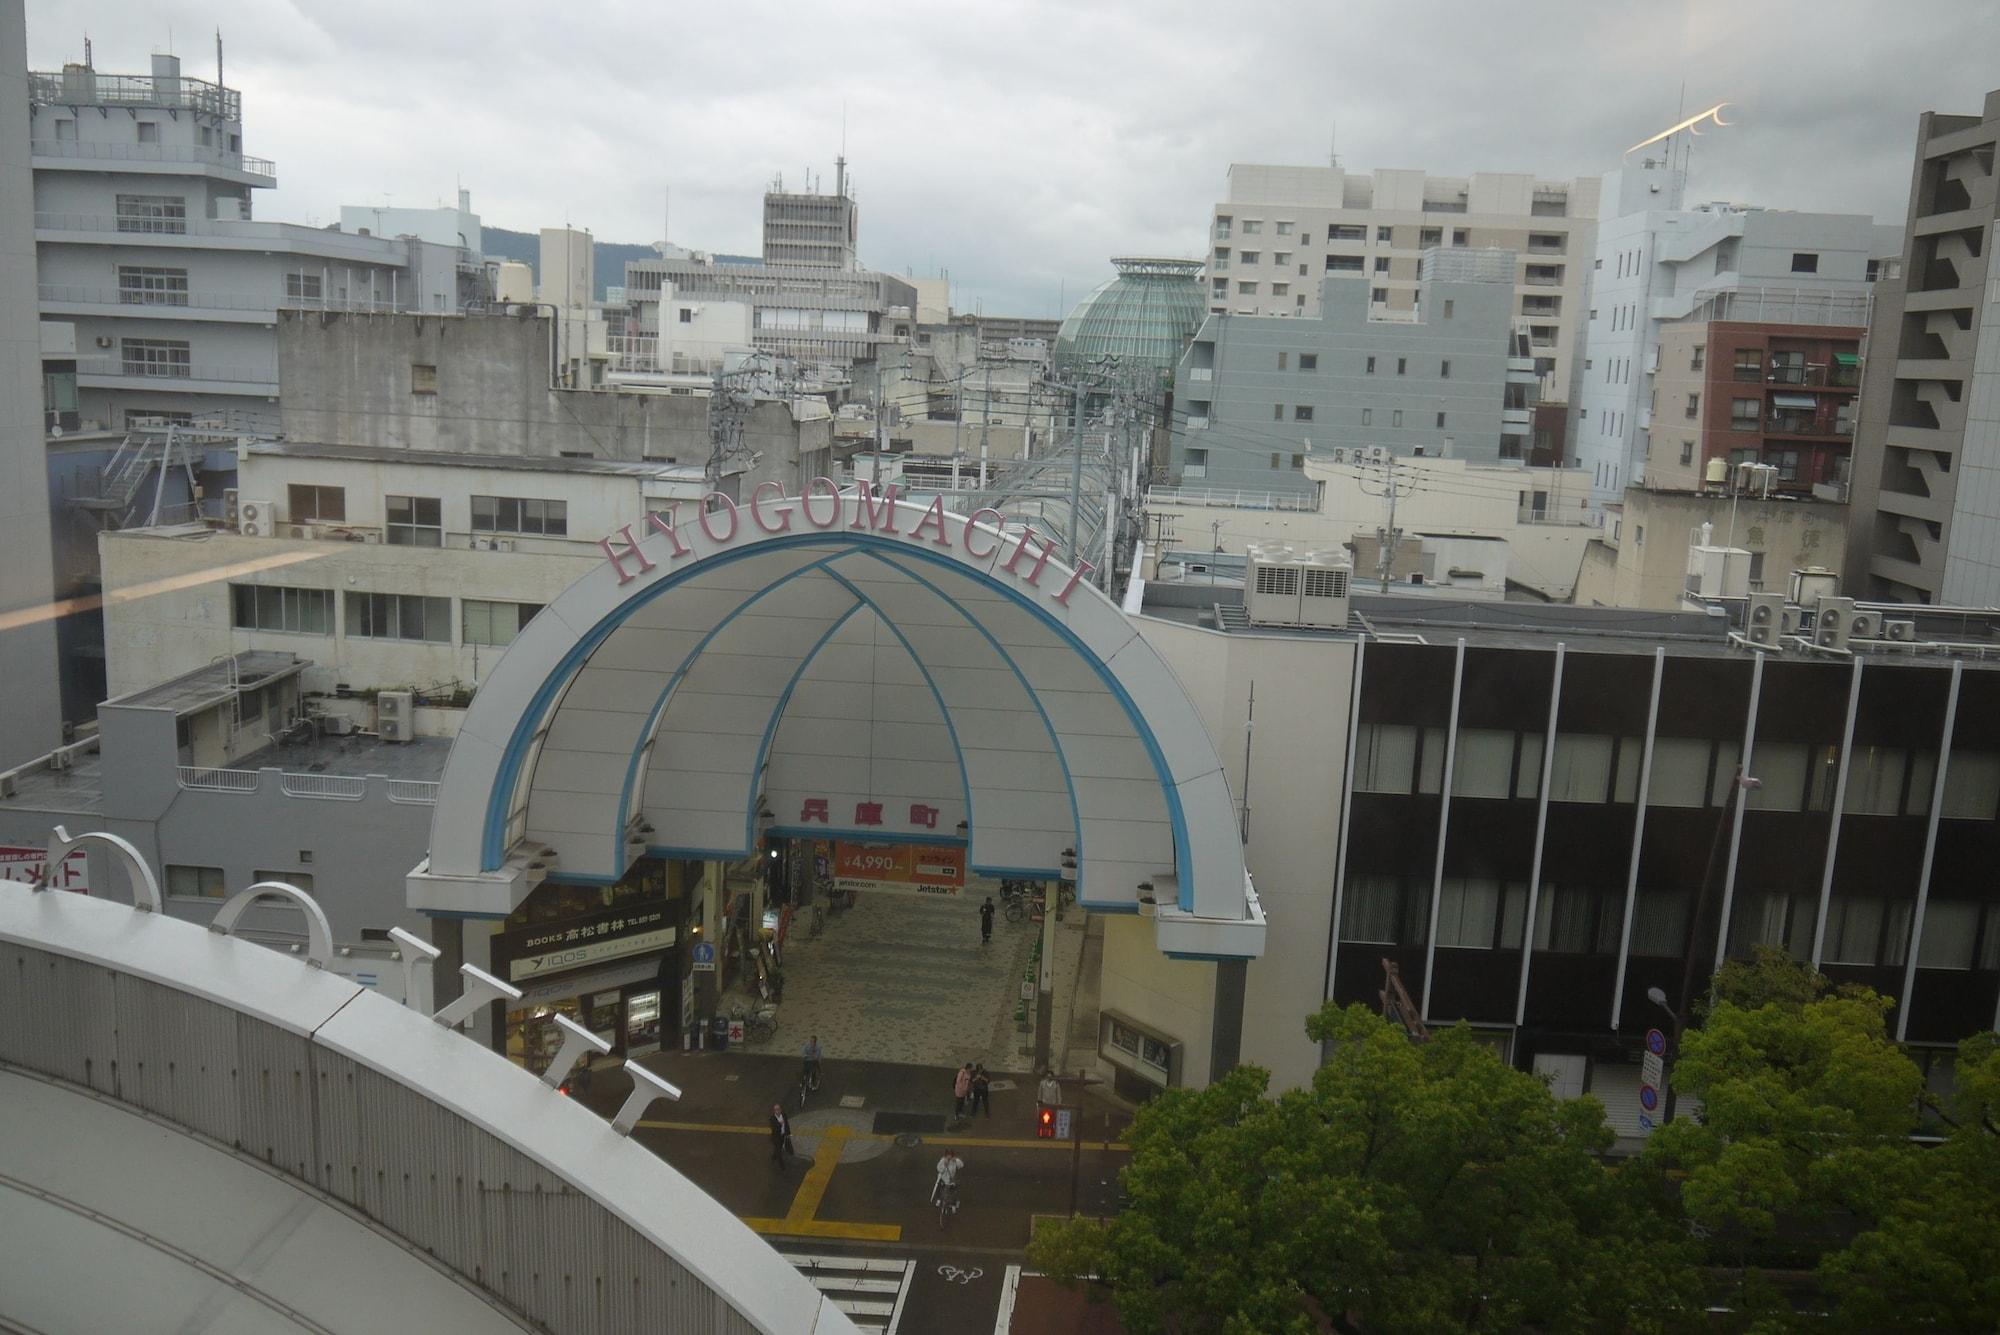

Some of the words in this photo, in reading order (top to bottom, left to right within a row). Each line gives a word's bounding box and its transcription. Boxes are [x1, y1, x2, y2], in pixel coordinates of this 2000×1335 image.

[599, 476, 1095, 609] HYOGOMACHI
[801, 798, 939, 829] 兵庫町
[917, 884, 948, 895] Jetstar
[527, 933, 563, 948] BOOKS
[566, 919, 625, 942] 高松書林
[547, 950, 586, 966] IQOS
